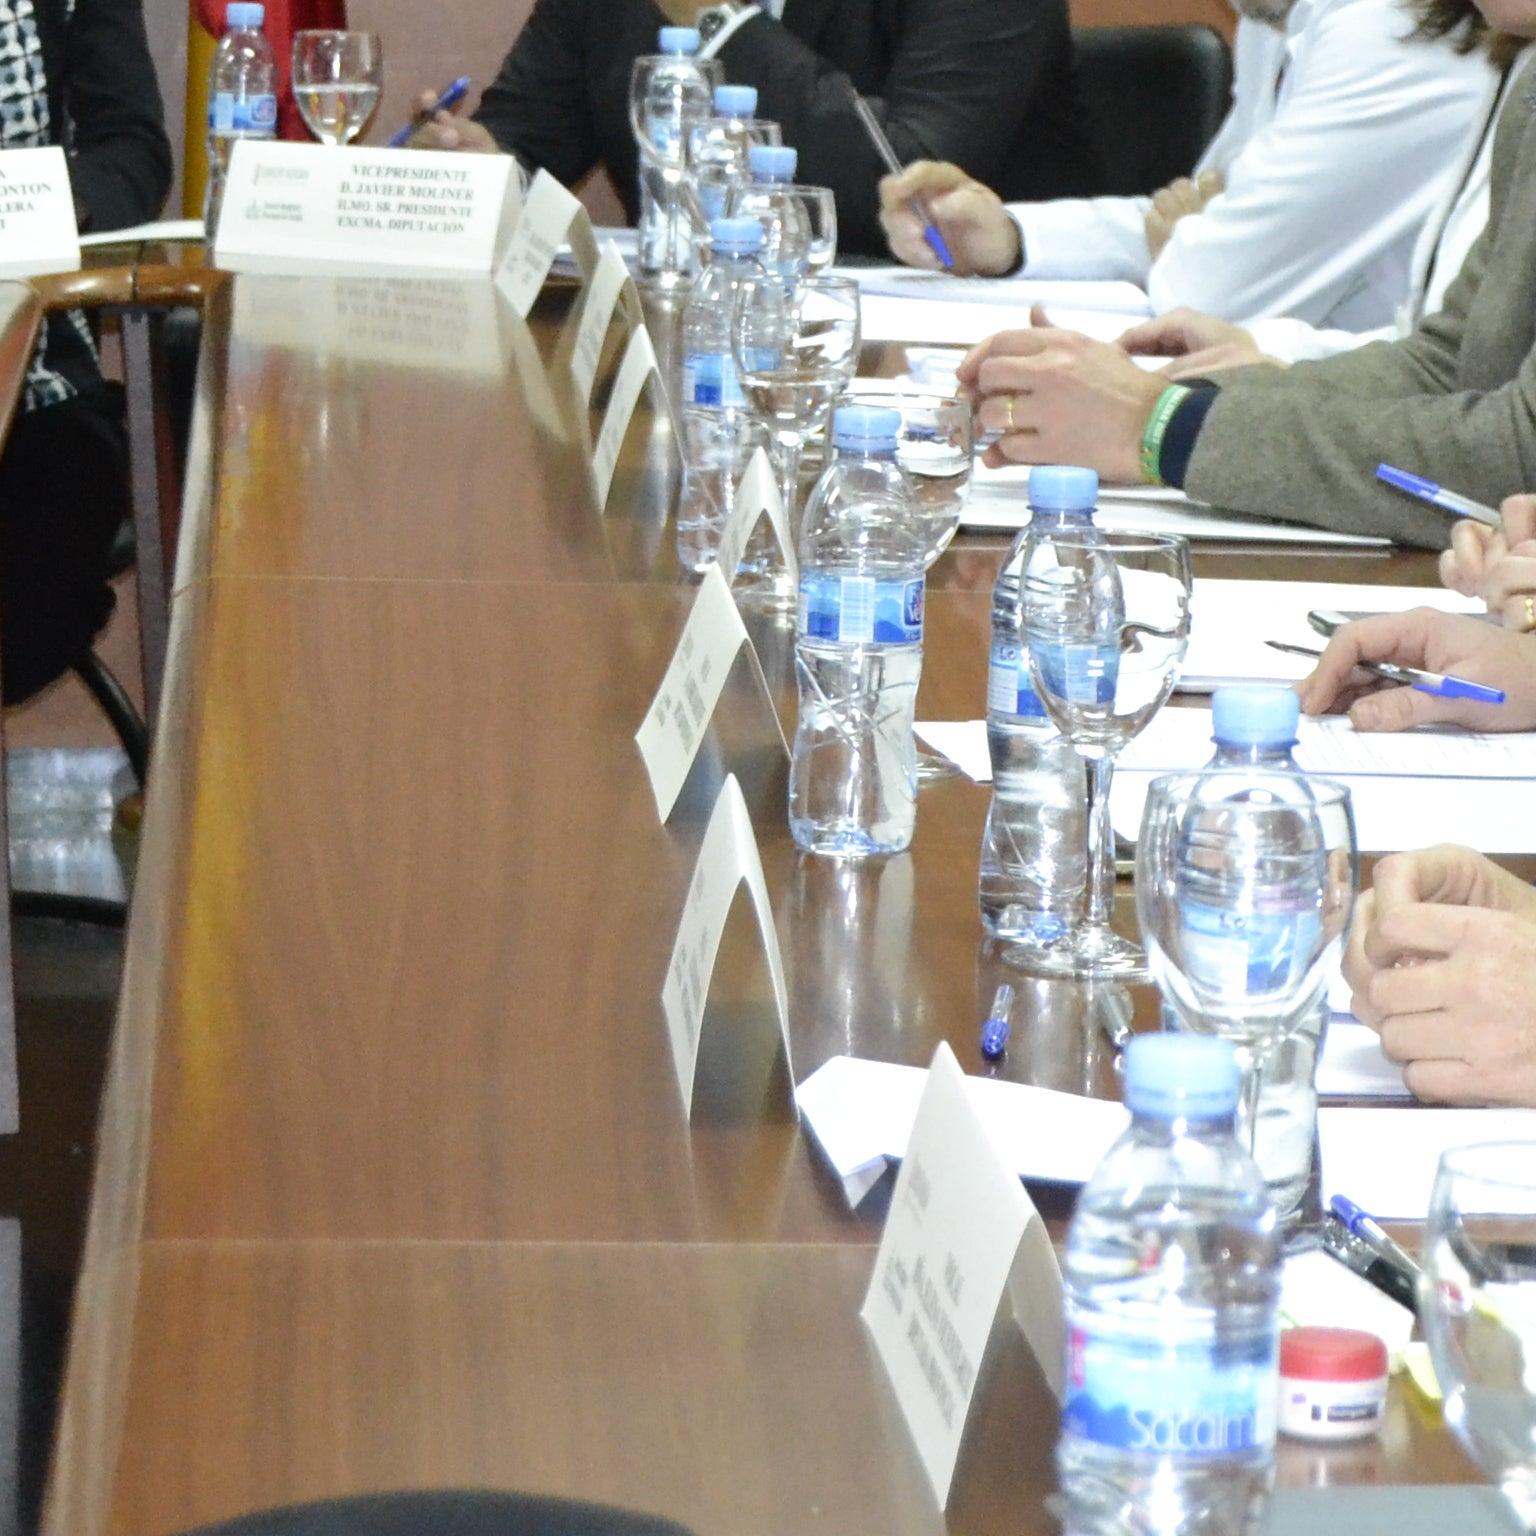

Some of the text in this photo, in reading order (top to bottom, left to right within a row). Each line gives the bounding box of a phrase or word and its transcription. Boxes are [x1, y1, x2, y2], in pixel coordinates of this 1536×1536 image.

[352, 164, 469, 182] VICEPRESIDENTE
[356, 183, 406, 197] JAVIER
[408, 185, 474, 201] MOLINER
[397, 203, 473, 218] PRESIDENTE
